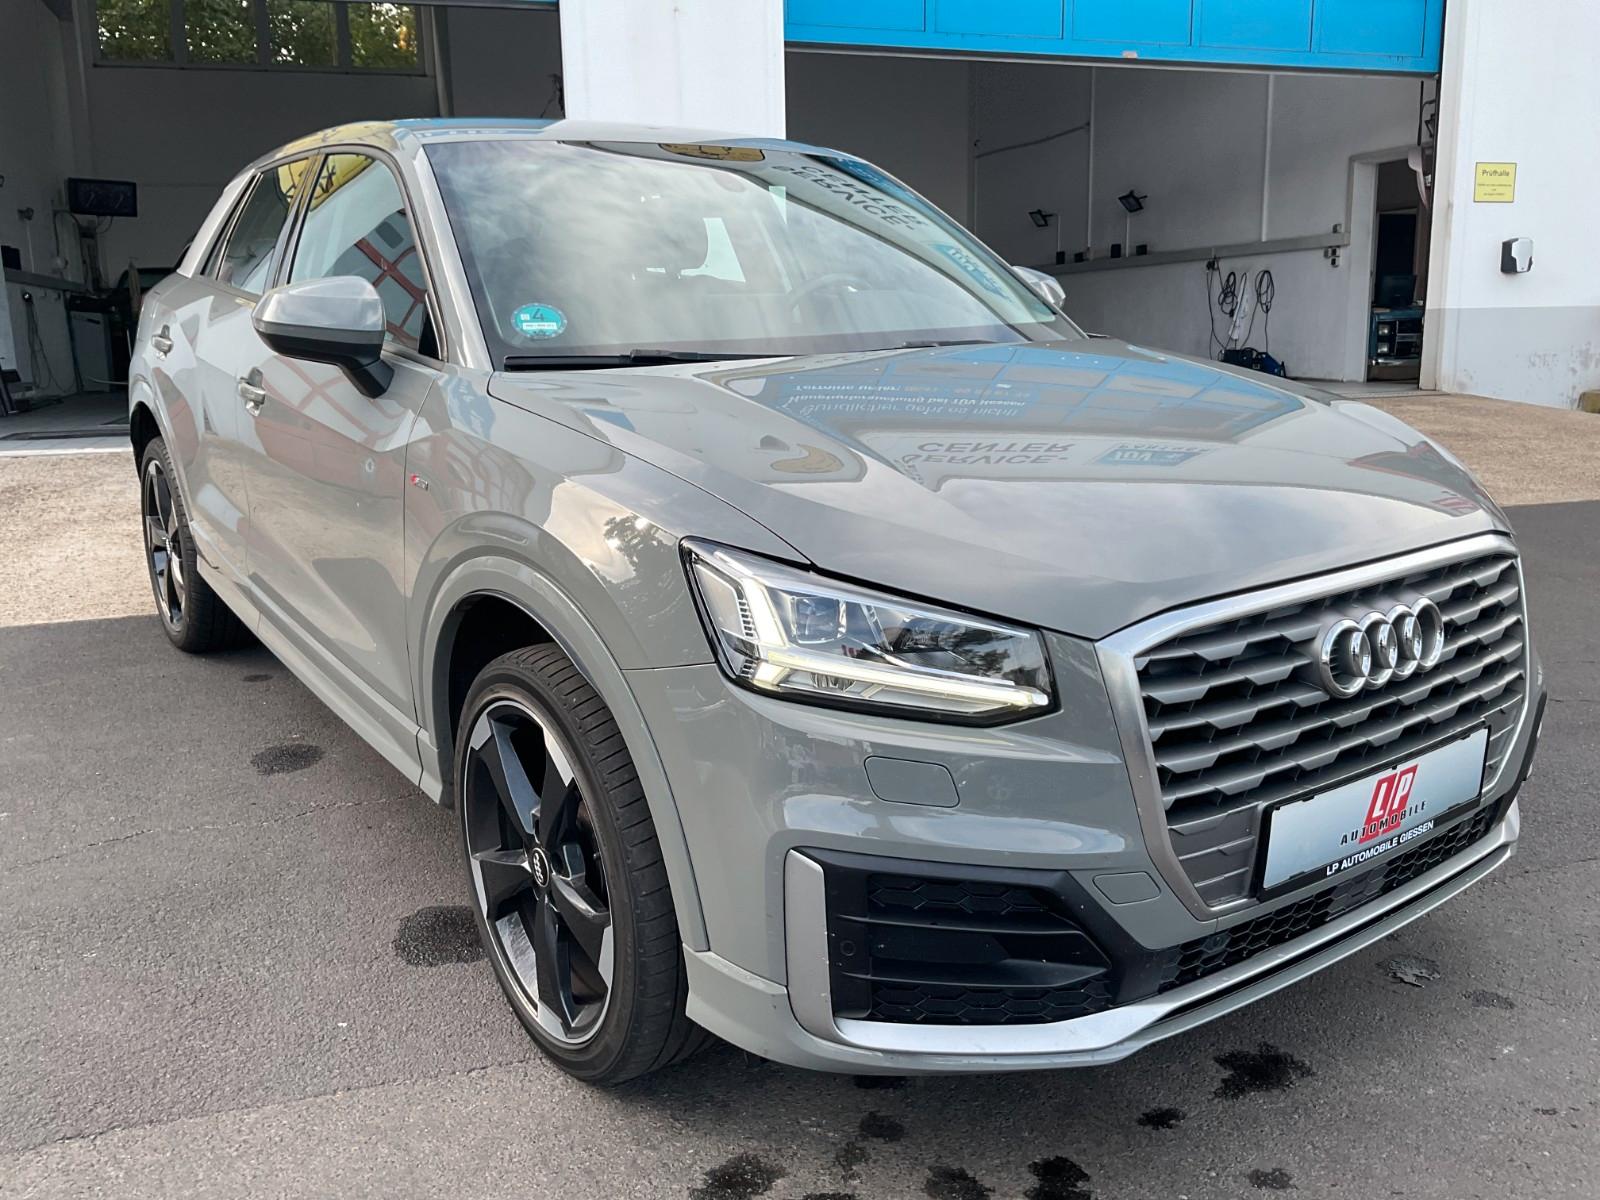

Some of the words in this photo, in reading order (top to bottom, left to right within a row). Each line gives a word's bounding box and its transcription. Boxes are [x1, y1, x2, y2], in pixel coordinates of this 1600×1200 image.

[1481, 169, 1510, 177] Prüfhalle
[533, 308, 545, 321] 4
[1371, 771, 1414, 818] LP
[1340, 800, 1426, 846] AUTOMOBILE
[1326, 863, 1339, 876] LP
[1340, 836, 1399, 870] AUTOMOBILE
[1399, 820, 1434, 843] GIESSEN
